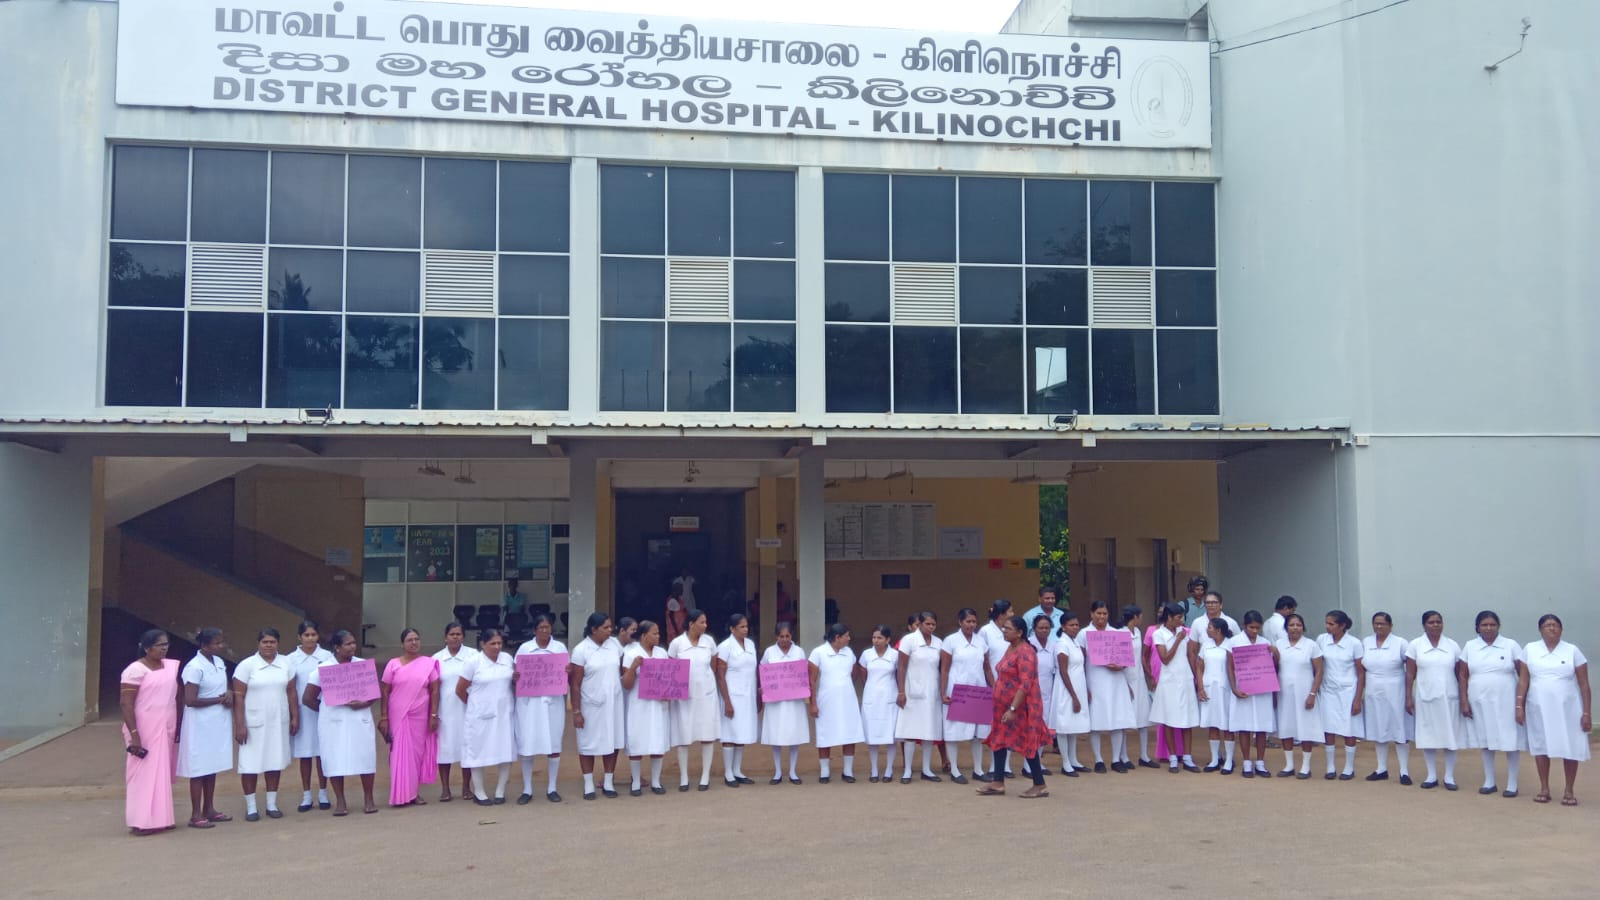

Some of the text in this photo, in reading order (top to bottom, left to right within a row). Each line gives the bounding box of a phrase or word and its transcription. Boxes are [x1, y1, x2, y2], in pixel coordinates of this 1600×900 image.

[215, 1, 386, 42] மாவட்ட
[400, 14, 530, 58] பொது
[544, 20, 860, 66] வைத்தியசாலை
[901, 37, 1121, 84] கிளிநொச்சி
[216, 42, 350, 75] දිසා
[375, 52, 487, 80] මහ
[511, 62, 733, 99] රෝහල
[806, 75, 1117, 111] කිලිනොච්චි
[212, 76, 417, 109] DISTRICT
[430, 87, 628, 120] GENERAL
[641, 98, 837, 130] HOSPITAL
[872, 110, 1122, 142] KILINOCHCHI
